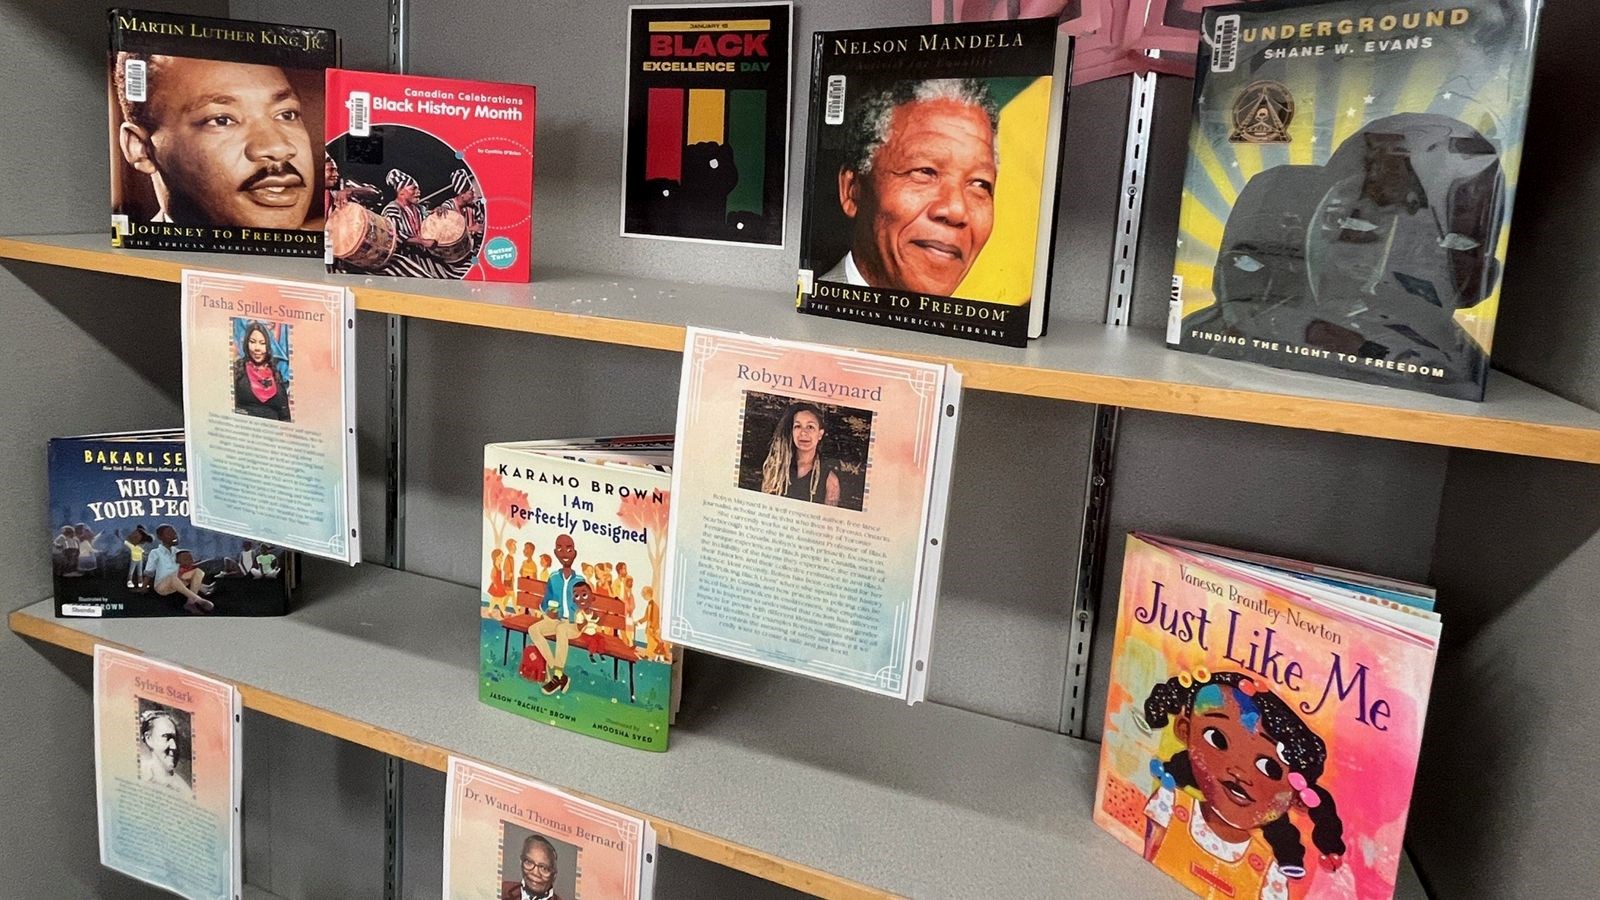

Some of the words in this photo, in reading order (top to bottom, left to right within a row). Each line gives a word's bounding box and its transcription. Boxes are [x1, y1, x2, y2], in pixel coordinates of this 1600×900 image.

[118, 16, 184, 36] MARTIN
[189, 23, 255, 43] LUTHER
[1242, 8, 1471, 43] UNDERGROUND
[649, 33, 769, 57] BLACK
[833, 38, 908, 56] NELSON
[918, 32, 1024, 51] MANDELA
[1263, 45, 1325, 60] SHANE
[1334, 42, 1355, 55] W.
[1364, 36, 1434, 53] EVANS
[642, 61, 736, 73] EXCELLENCE
[740, 62, 771, 72] DAY
[373, 96, 414, 112] Black
[417, 100, 471, 120] History
[474, 105, 523, 121] Month
[404, 88, 454, 100] Canadian
[457, 92, 524, 106] Celebrations
[128, 222, 204, 238] JOURNEY
[212, 229, 234, 240] TO
[241, 229, 320, 244] FREEDOM
[157, 241, 206, 249] AFRICAN
[212, 244, 268, 253] AMERICAN
[273, 247, 319, 255] LIBRARY
[487, 246, 514, 256] Butter
[490, 253, 513, 261] Tarts
[201, 294, 234, 311] Tasha
[237, 299, 325, 322] Spillet-Sumner
[811, 282, 882, 304] JOURNEY
[890, 295, 911, 308] TO
[919, 297, 1007, 322] FREEDOM
[811, 302, 830, 311] THE
[836, 306, 881, 319] AFRICAN
[887, 314, 946, 329] AMERICAN
[953, 324, 1006, 338] LIBRARY
[1191, 329, 1247, 346] FINDING
[1252, 339, 1280, 351] THE
[1285, 344, 1330, 360] LIGHT
[1337, 352, 1358, 364] TO
[1365, 357, 1445, 378] FREEDOM
[736, 363, 793, 388] Robyn
[798, 373, 882, 402] Maynard
[84, 449, 153, 465] BAKARI
[115, 478, 160, 499] WHO
[499, 463, 580, 488] KARAMO
[591, 481, 664, 504] BROWN
[87, 499, 145, 522] YOUR
[562, 494, 567, 507] I
[570, 495, 594, 512] Am
[510, 504, 578, 534] Perfectly
[582, 519, 648, 544] Designed
[1178, 564, 1224, 597] Vanessa
[1228, 585, 1342, 645] Brantley-Newton
[1134, 580, 1212, 651] Just
[1222, 608, 1304, 692] Like
[1299, 652, 1392, 732] Me
[134, 676, 164, 694] Sylvia
[166, 687, 193, 703] Stark
[489, 692, 512, 703] JASON
[514, 699, 548, 714] "RACHEL"
[549, 710, 577, 723] BROWN
[592, 722, 629, 738] ANOOSHA
[632, 733, 653, 744] SYED
[464, 787, 482, 802] Dr.
[484, 793, 524, 817] Wanda
[526, 808, 573, 834] Thomas
[576, 825, 625, 851] Bernard
